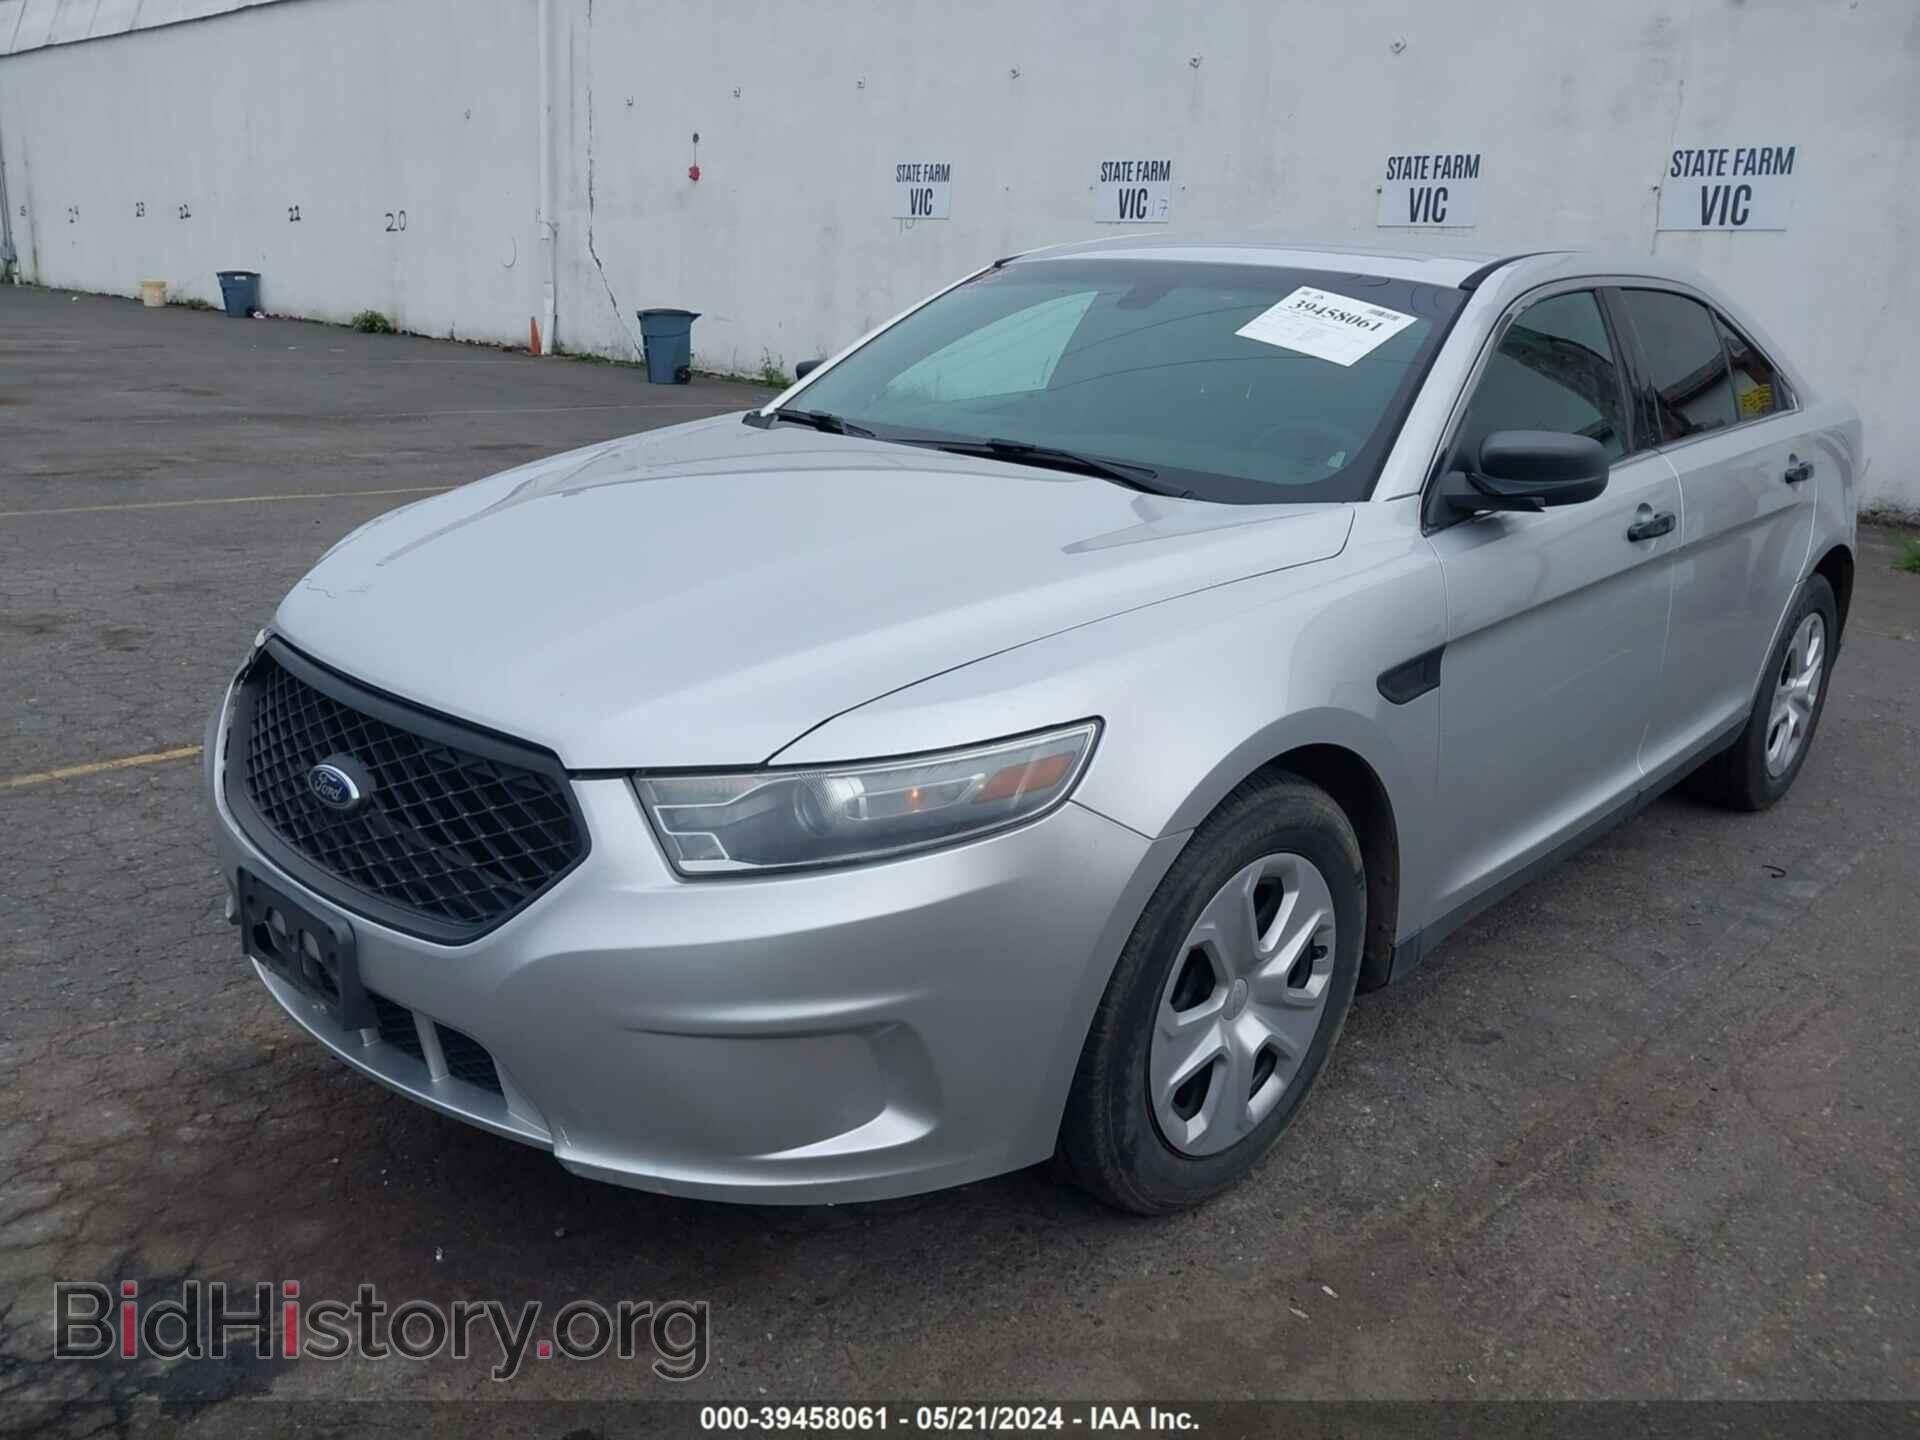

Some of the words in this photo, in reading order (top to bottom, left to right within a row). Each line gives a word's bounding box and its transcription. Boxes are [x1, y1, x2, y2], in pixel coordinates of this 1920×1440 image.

[896, 163, 922, 183] STATE
[923, 163, 951, 183] FARM
[1100, 161, 1134, 182] STATE
[1136, 160, 1171, 182] FARM
[1386, 155, 1430, 181] STATE
[1432, 153, 1481, 180] FARM
[1670, 149, 1730, 177] STATE
[1733, 146, 1796, 176] FARM
[910, 187, 933, 216] VIC
[1119, 188, 1148, 219] VIC
[1409, 186, 1448, 223] VIC
[1701, 184, 1752, 226] VIC
[385, 210, 407, 232] 20
[1288, 299, 1384, 332] 39458061
